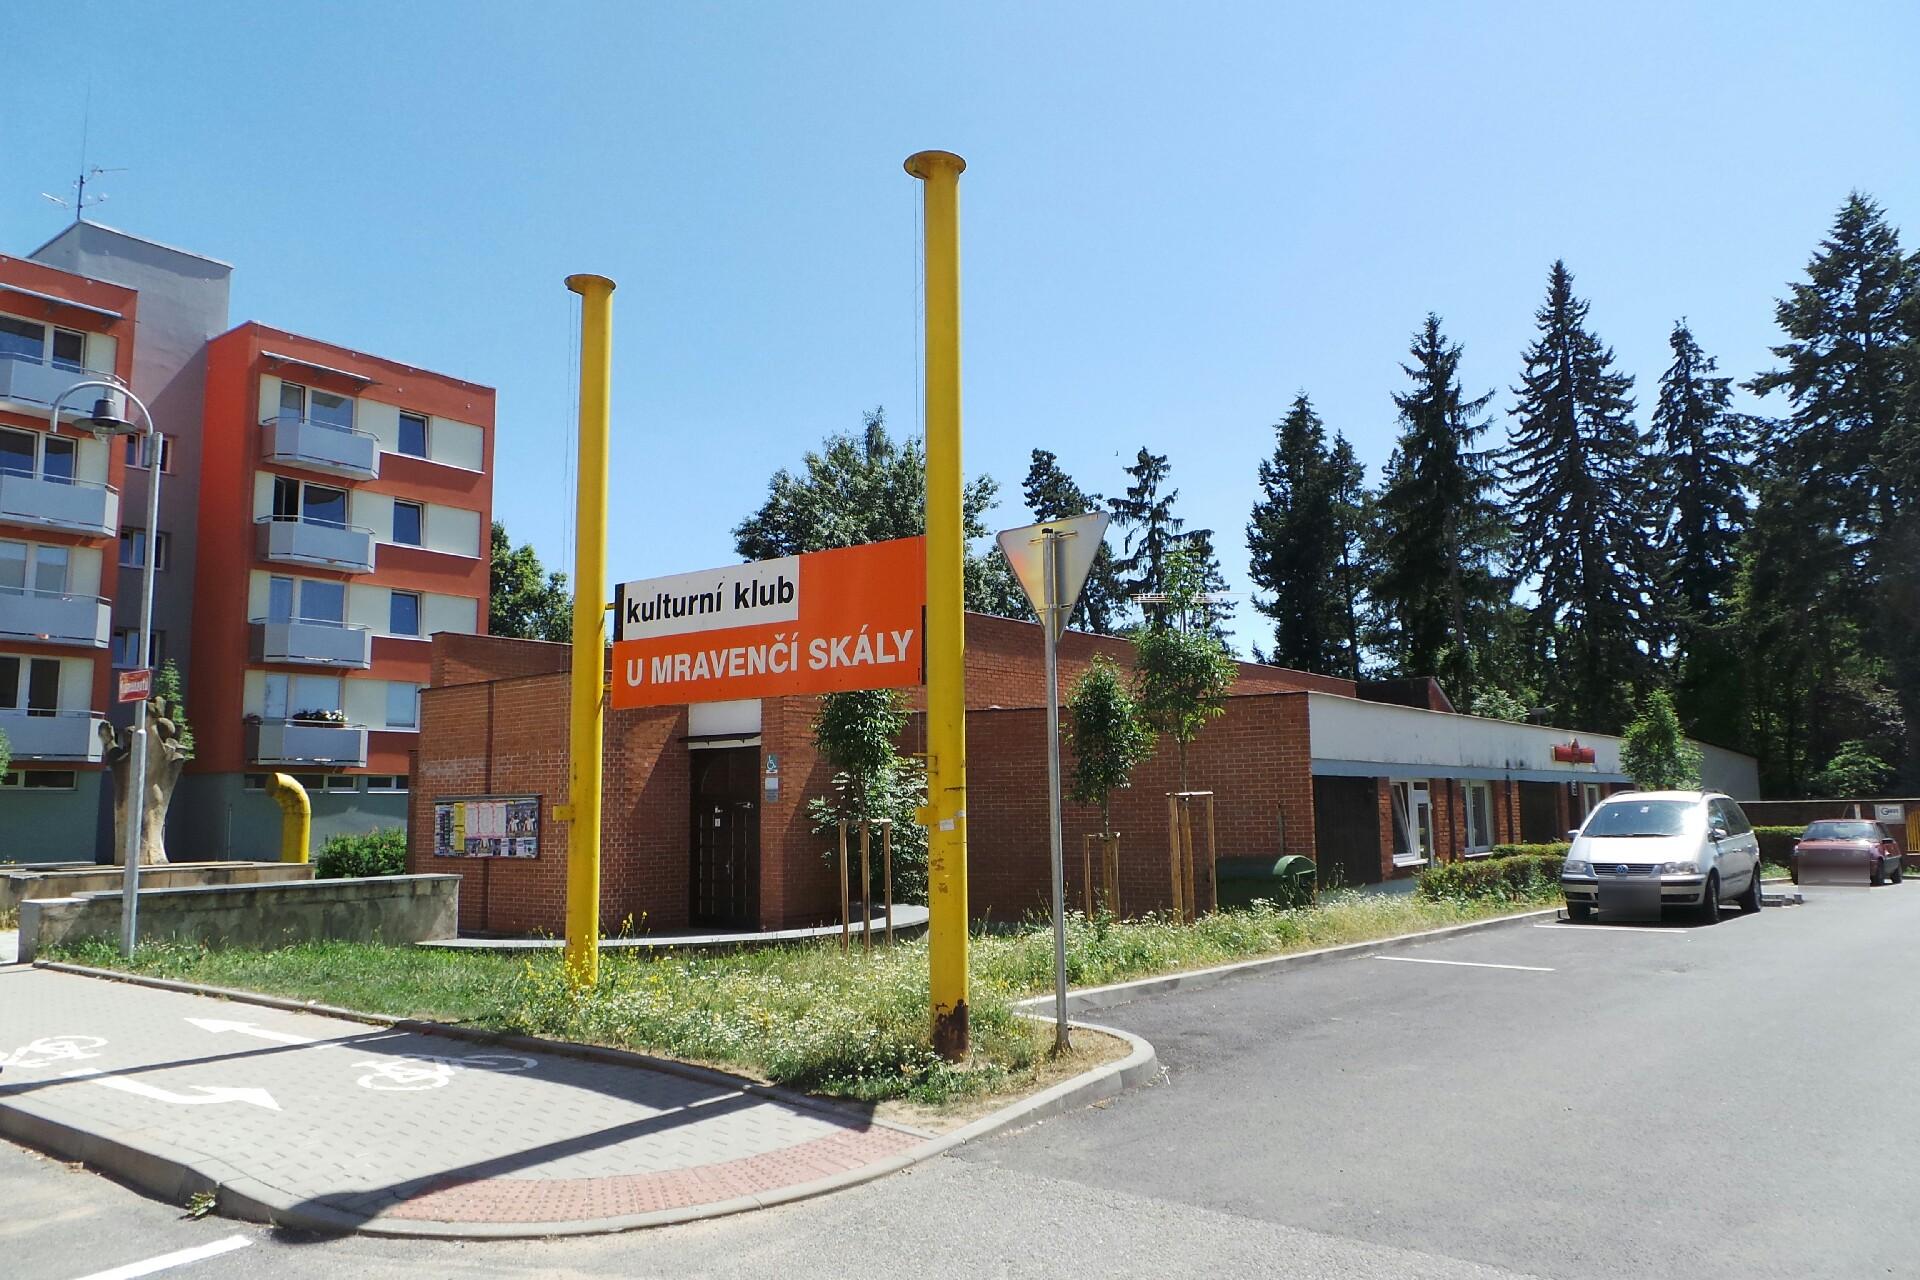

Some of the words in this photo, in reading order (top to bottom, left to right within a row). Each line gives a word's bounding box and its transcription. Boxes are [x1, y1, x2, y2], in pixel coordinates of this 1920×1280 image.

[627, 582, 723, 624] kulturní
[734, 575, 795, 610] klub
[626, 659, 643, 687] U
[651, 631, 799, 684] MRAVENČÍ
[808, 624, 914, 670] SKÁLY
